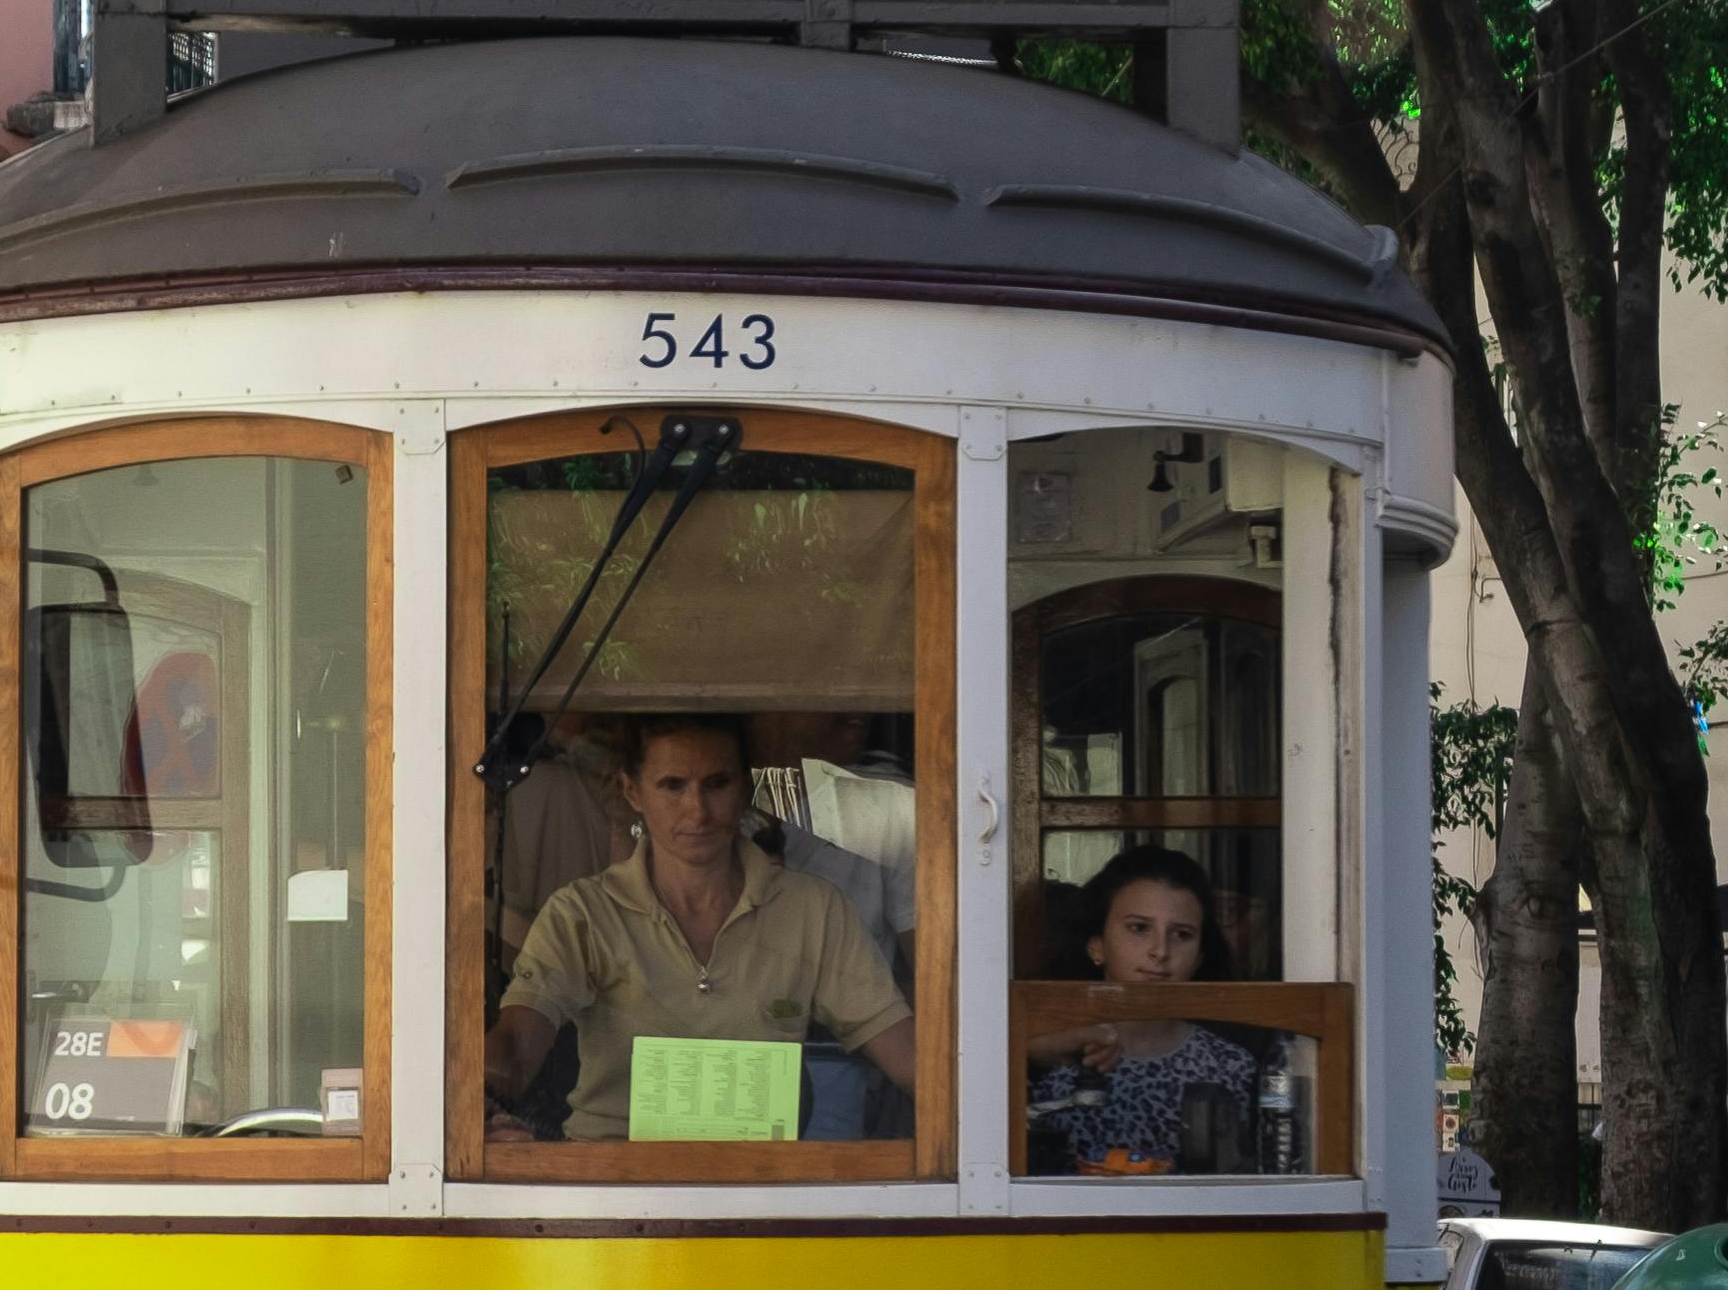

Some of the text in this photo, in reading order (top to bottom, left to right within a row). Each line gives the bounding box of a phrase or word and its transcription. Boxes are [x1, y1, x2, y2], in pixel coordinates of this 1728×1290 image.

[639, 313, 776, 370] 543
[54, 1031, 104, 1057] 28E
[45, 1082, 95, 1120] 08
